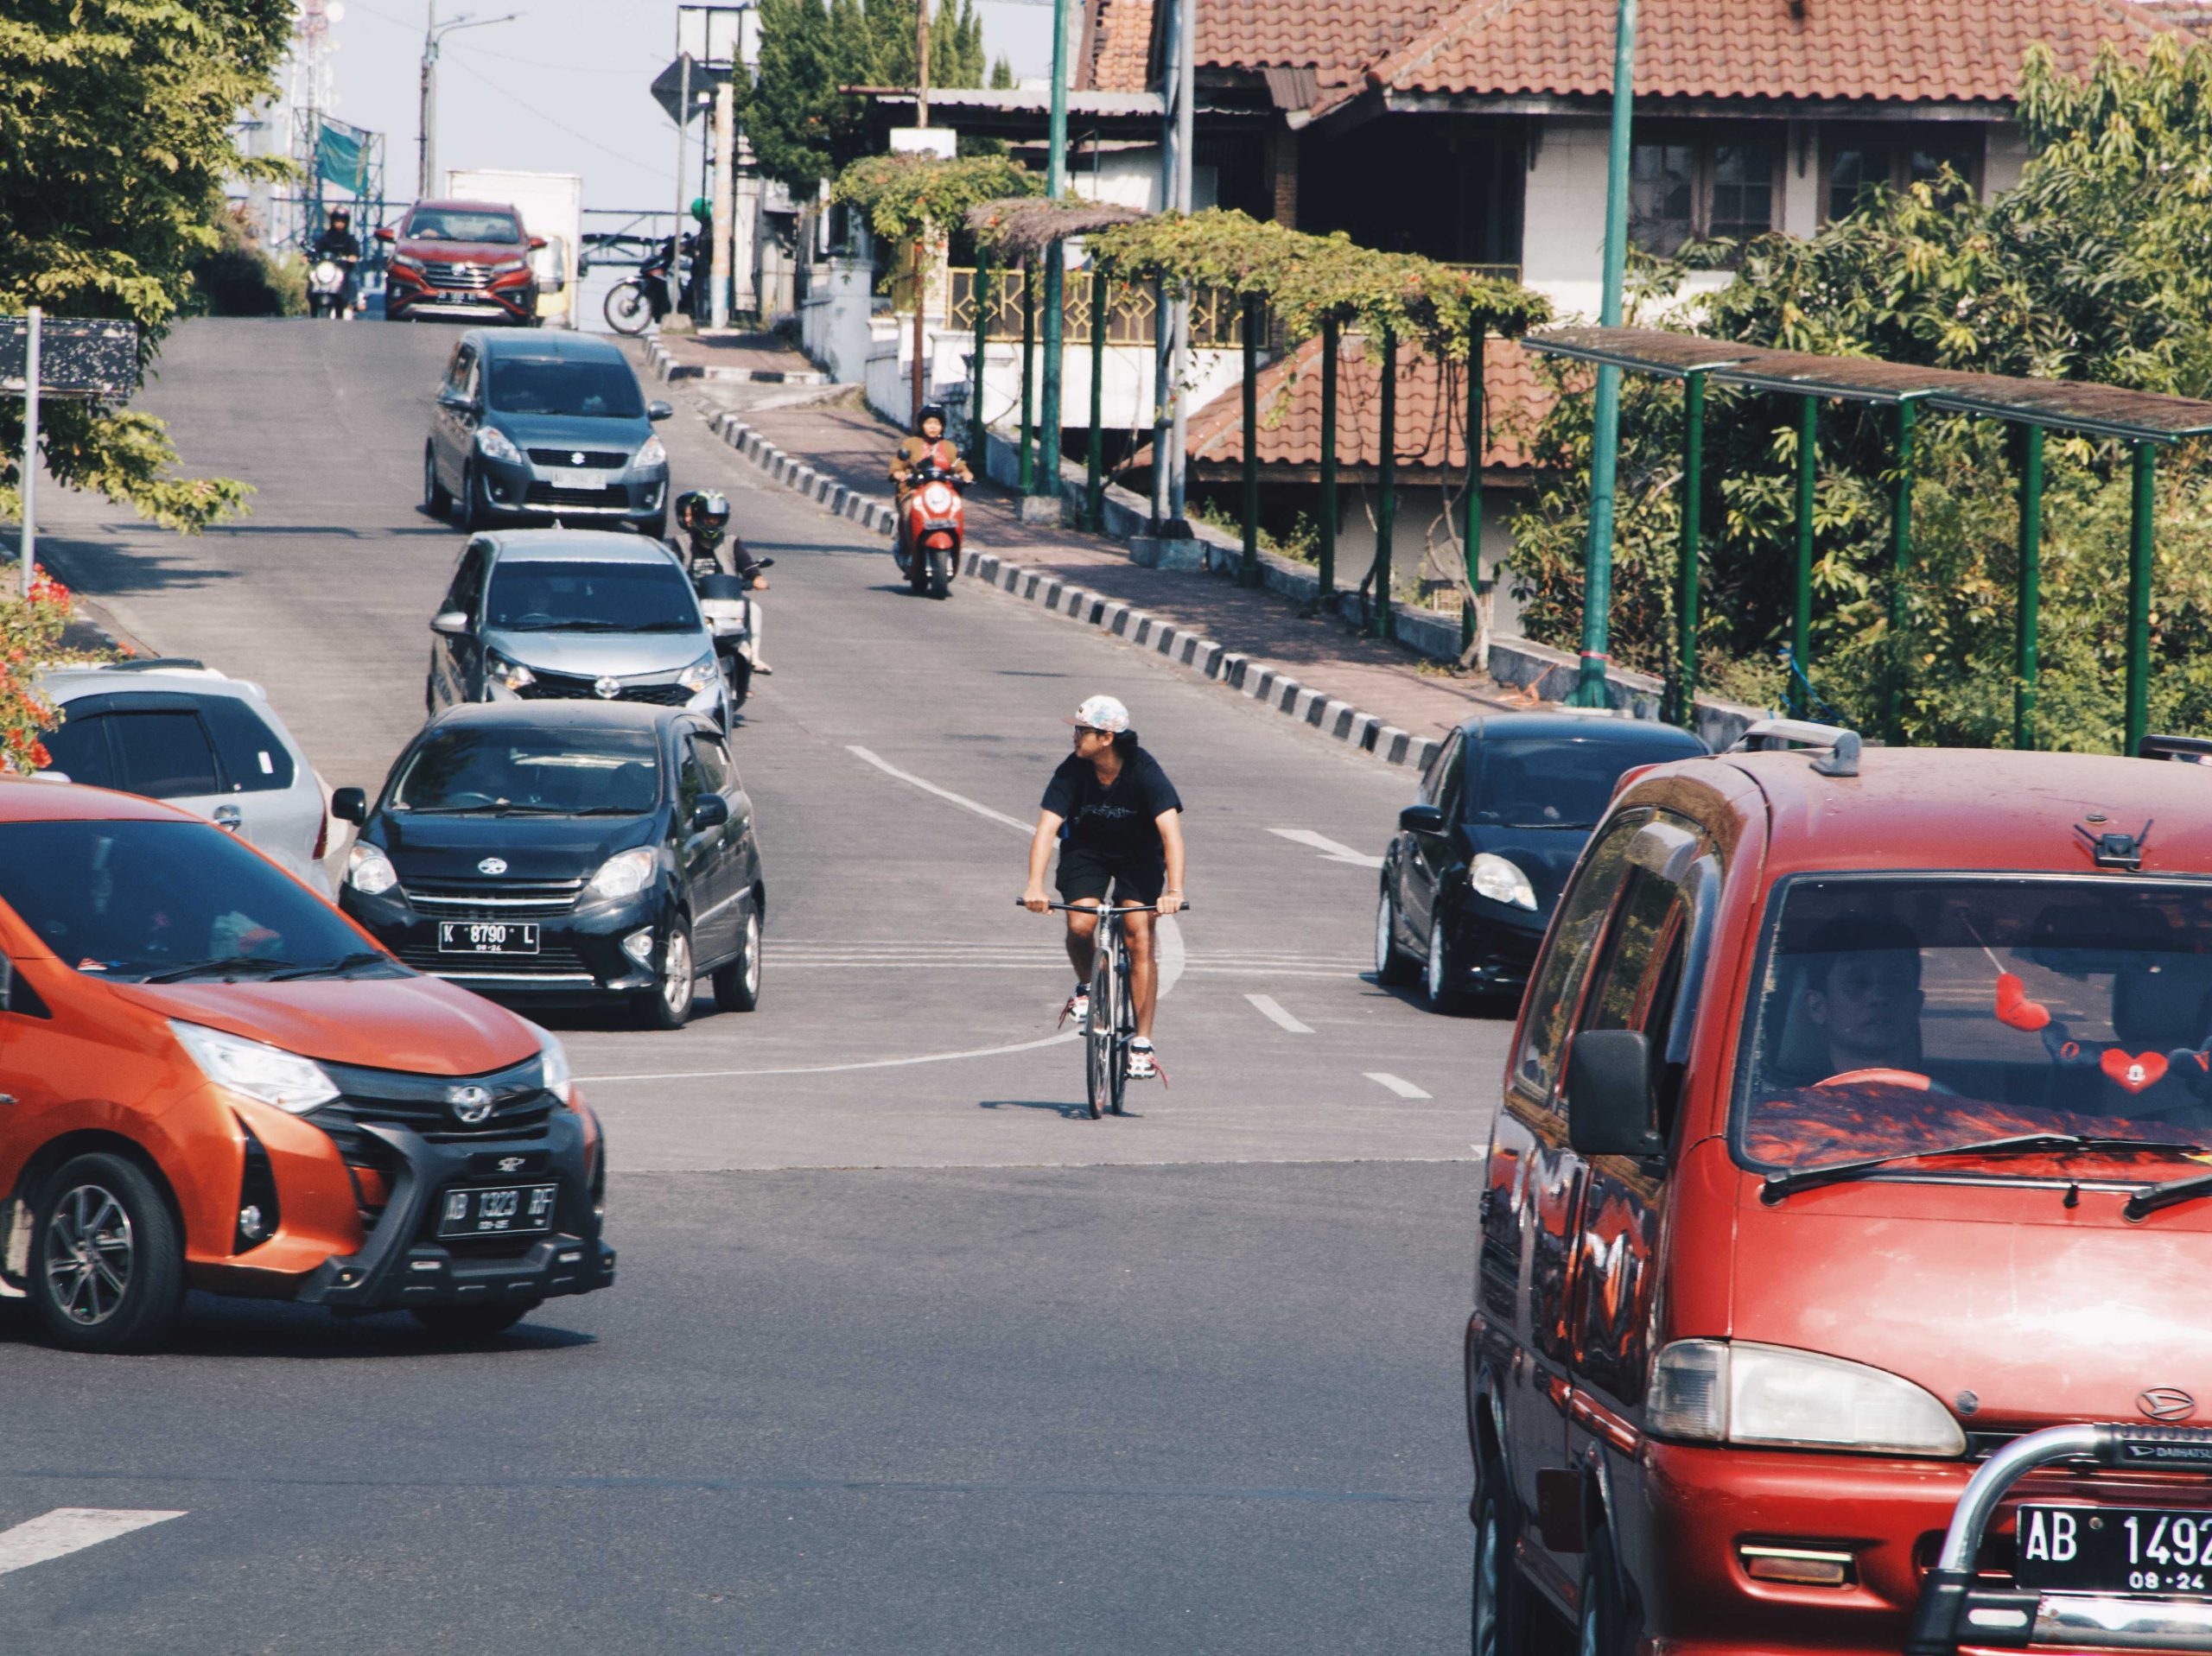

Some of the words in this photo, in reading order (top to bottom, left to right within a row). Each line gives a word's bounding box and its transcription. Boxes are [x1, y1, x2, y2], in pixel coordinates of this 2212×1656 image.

[443, 924, 454, 942] K
[470, 925, 506, 943] 8790
[524, 925, 535, 944] L
[2025, 1511, 2077, 1562] AB
